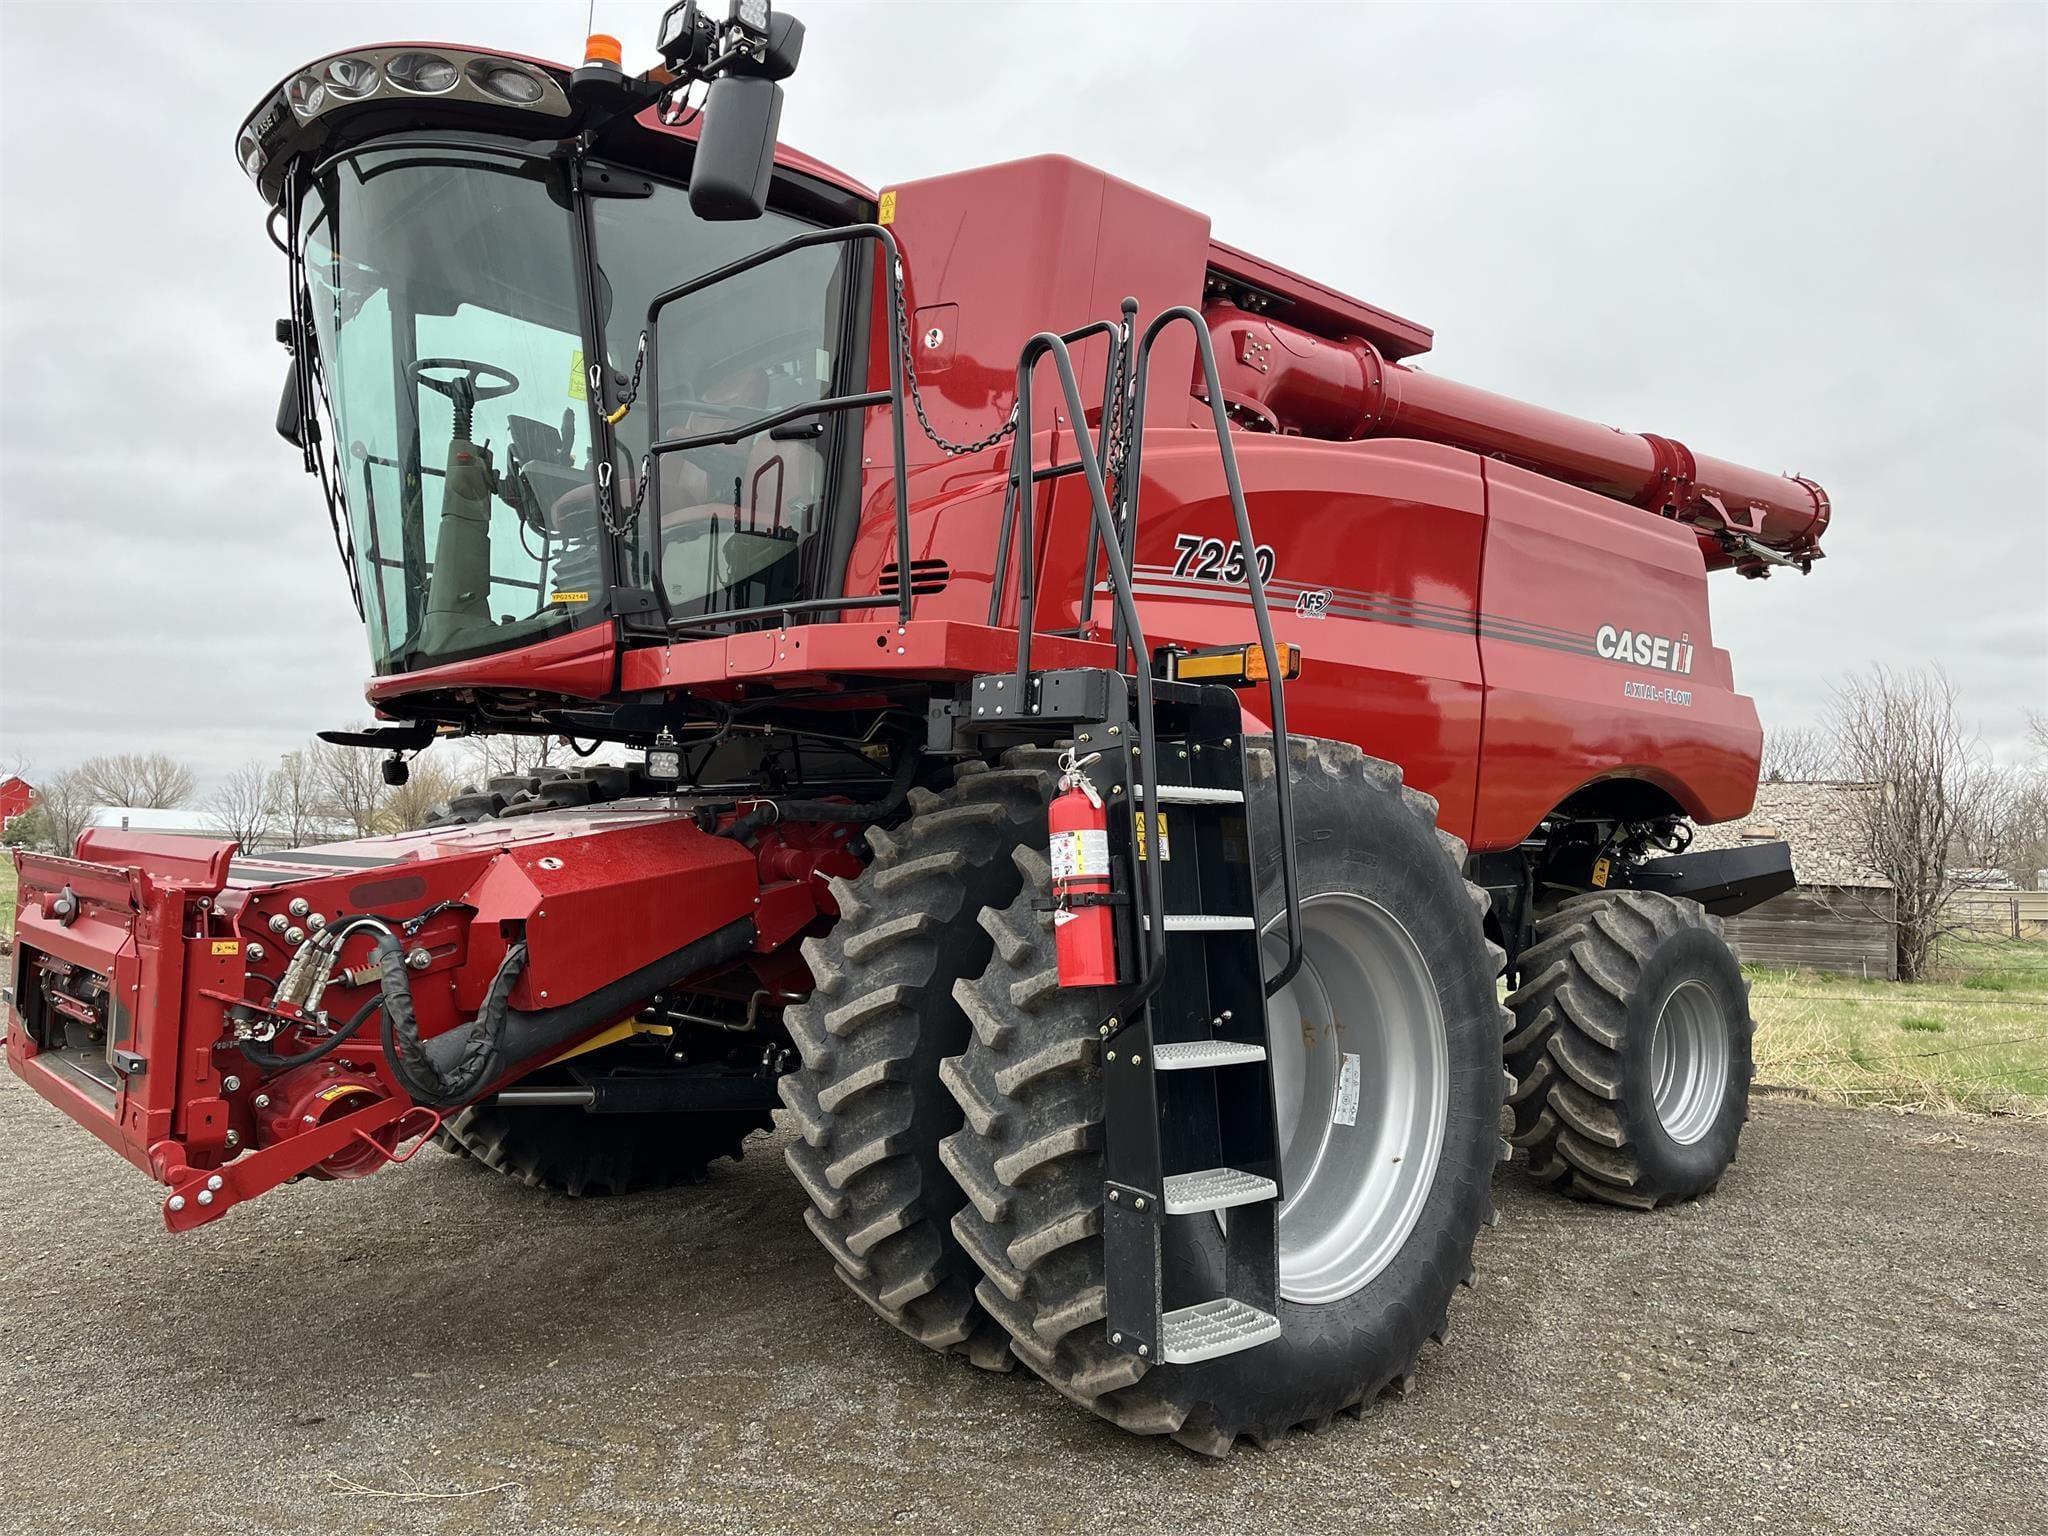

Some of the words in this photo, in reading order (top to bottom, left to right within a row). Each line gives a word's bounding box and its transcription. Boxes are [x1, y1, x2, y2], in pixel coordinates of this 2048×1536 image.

[1171, 533, 1276, 586] 7250
[1295, 590, 1325, 611] AFS
[1595, 623, 1670, 670] CASE
[1624, 681, 1692, 707] AXIAL-FLOW
